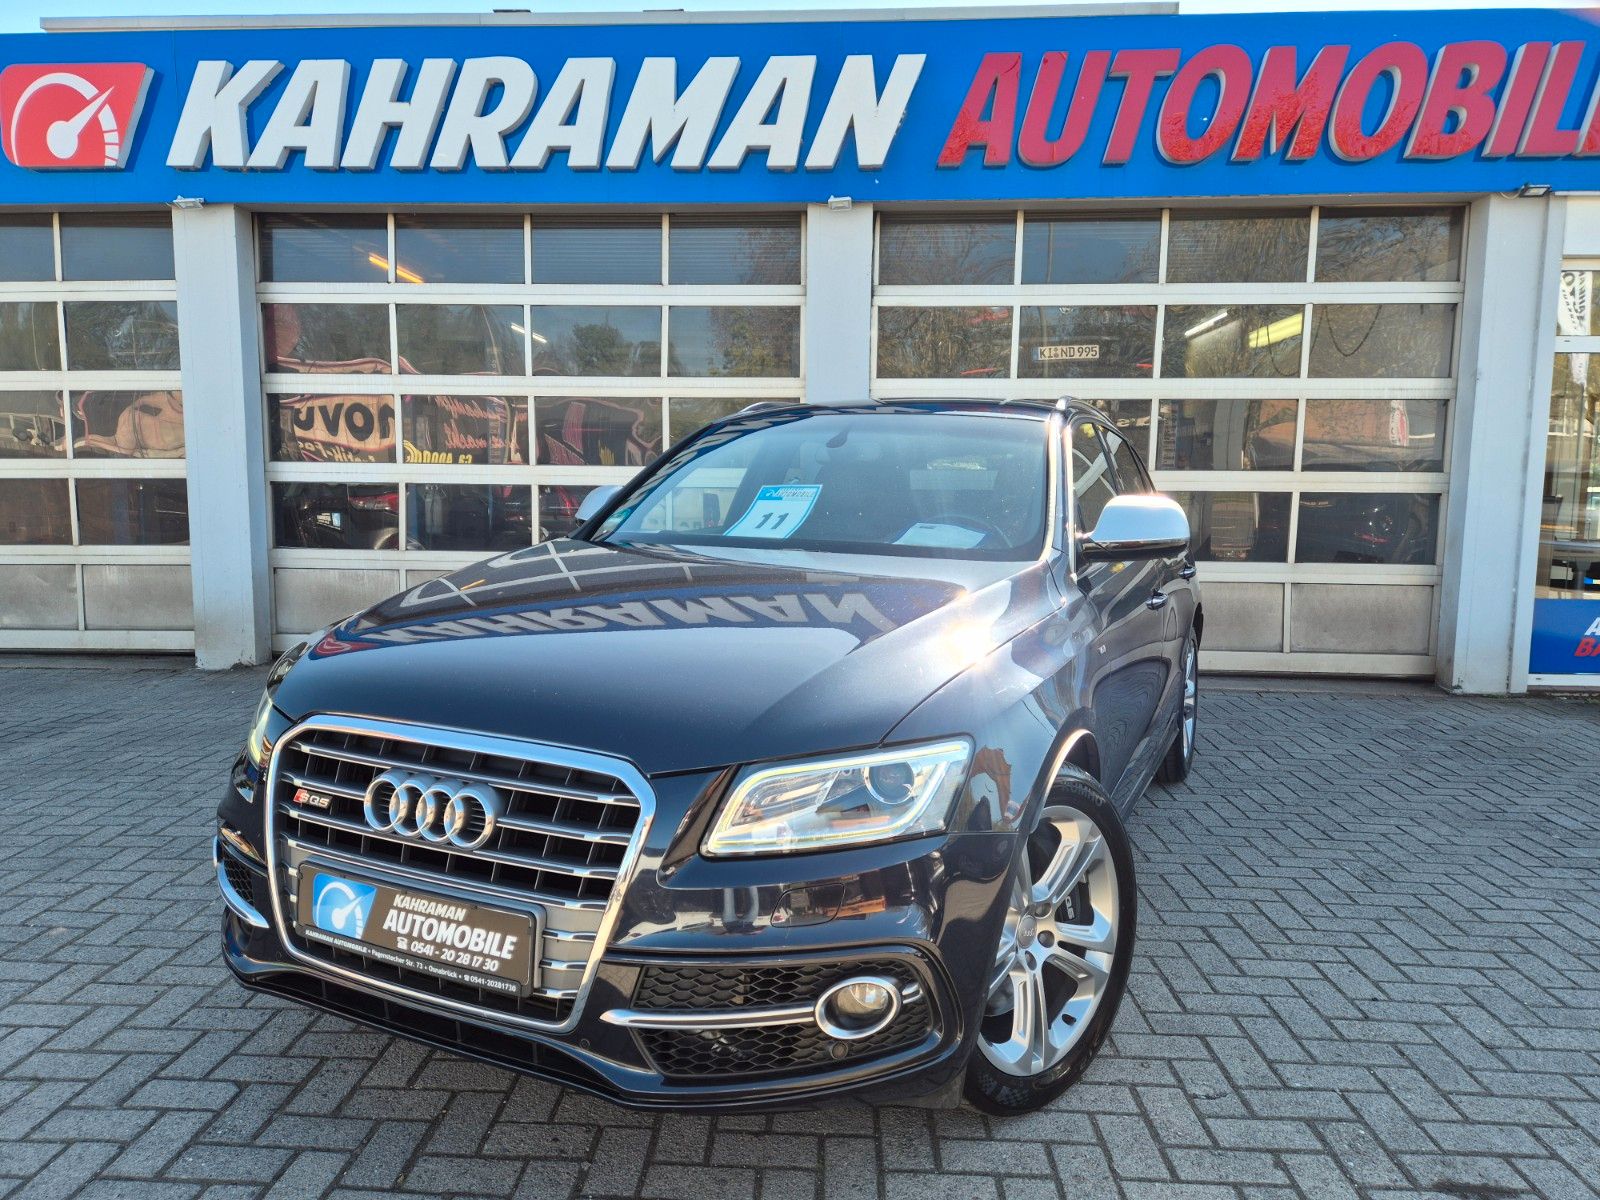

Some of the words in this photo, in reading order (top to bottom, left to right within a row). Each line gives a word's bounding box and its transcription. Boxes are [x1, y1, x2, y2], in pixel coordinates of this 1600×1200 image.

[166, 54, 926, 170] KAHRAMAN
[1060, 347, 1076, 358] ND
[1077, 346, 1098, 358] 995
[755, 512, 790, 530] 11
[295, 789, 330, 809] SQ5
[393, 894, 467, 921] KAHRAMAN
[382, 909, 518, 959] AUTOMOBILE
[305, 929, 334, 943] KAHRAMAN
[333, 937, 367, 953] AUTOMOBILE
[405, 958, 415, 967] Str.
[416, 962, 423, 970] 73
[428, 965, 457, 979] Osnabrück
[470, 975, 517, 992] 0541-20281730
[410, 941, 434, 956] 0541
[440, 948, 456, 961] 20
[456, 952, 471, 965] 28
[471, 955, 483, 967] 17
[483, 958, 499, 971] 30
